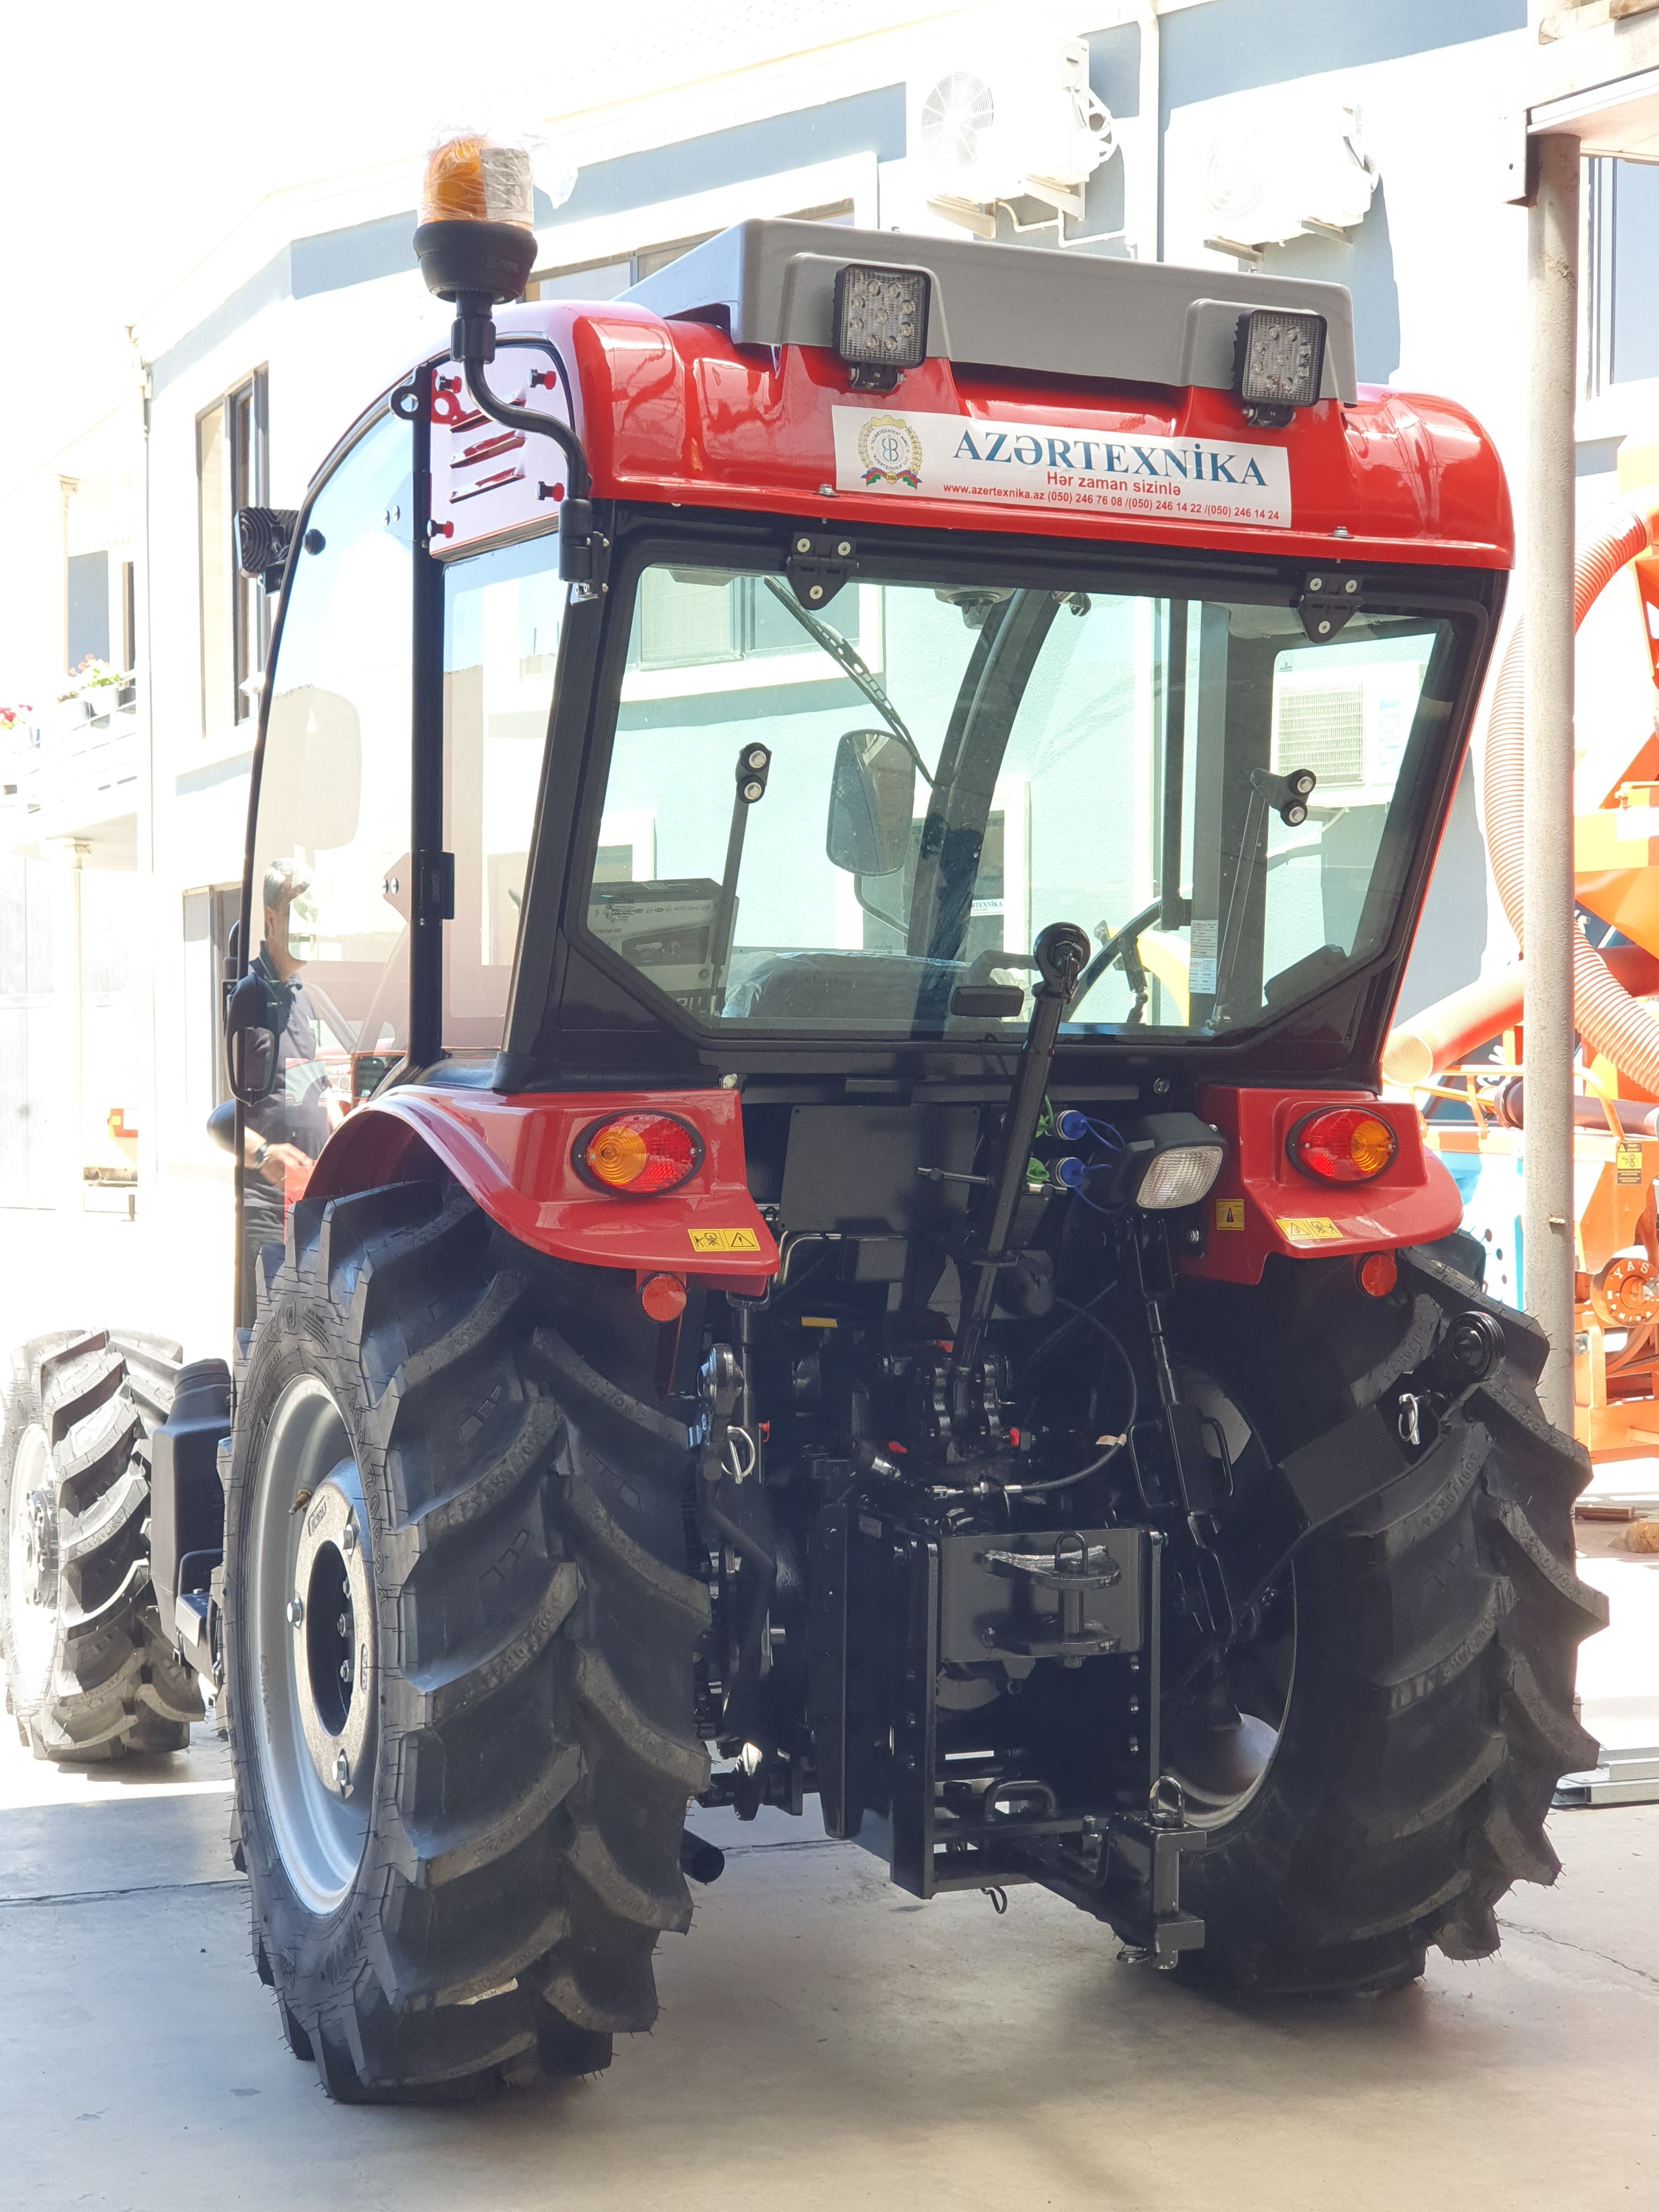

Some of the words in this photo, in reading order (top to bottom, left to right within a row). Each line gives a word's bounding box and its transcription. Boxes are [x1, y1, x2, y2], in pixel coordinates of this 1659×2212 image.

[952, 429, 1268, 486] AZƏRTEXNİKA
[1047, 471, 1074, 486] Hər
[1078, 476, 1128, 492] zaman
[1133, 479, 1181, 496] sizinlə
[943, 484, 1045, 500] www.azertexnika.az
[1048, 491, 1073, 504] (050)
[1075, 493, 1093, 504] 246
[1097, 495, 1108, 505] 76
[1111, 496, 1122, 506] 08
[1156, 501, 1173, 511] 246
[1177, 502, 1187, 512] 14
[1190, 503, 1201, 514] 22
[1235, 507, 1251, 517] 246
[1255, 509, 1265, 518] 14
[1268, 510, 1279, 520] 24
[1613, 1260, 1650, 1279] YAS
